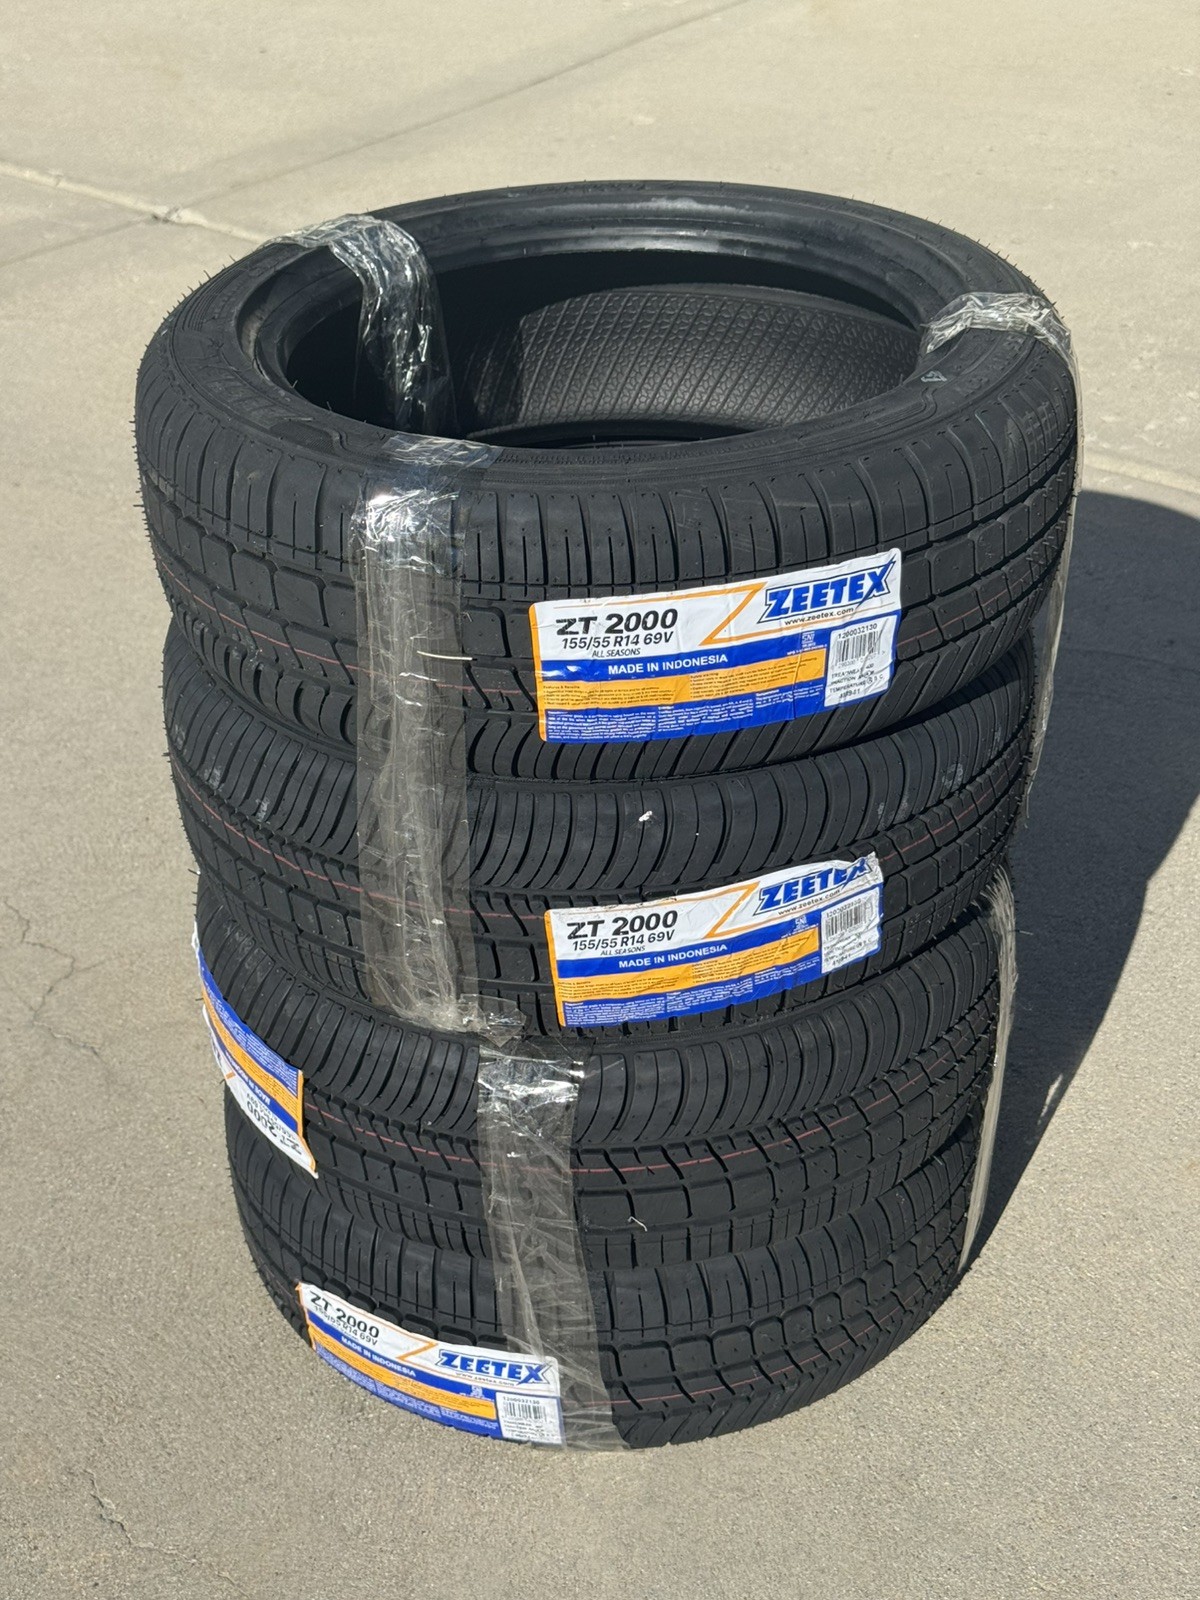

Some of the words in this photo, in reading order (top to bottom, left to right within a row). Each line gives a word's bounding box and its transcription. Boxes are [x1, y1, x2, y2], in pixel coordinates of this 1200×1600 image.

[764, 554, 896, 619] ZEETEX
[555, 616, 598, 635] ZT
[604, 608, 678, 634] 2000
[784, 606, 854, 626] www.zeetex.com
[562, 636, 611, 650] 155/55
[613, 634, 640, 647] R14
[643, 631, 674, 645] 69V
[592, 650, 605, 658] ALL
[606, 647, 641, 657] SEASONS
[608, 663, 644, 675] MADE
[647, 662, 659, 672] IN
[662, 654, 728, 671] INDONESIA
[759, 858, 867, 911] ZEETEX
[566, 919, 605, 940] ZT
[612, 910, 678, 936] 2000
[572, 938, 618, 951] 155/55
[620, 934, 645, 947] R14
[647, 930, 675, 944] 69V
[614, 945, 646, 955] SEASONS
[618, 957, 652, 968] MADE
[654, 955, 665, 964] IN
[667, 944, 728, 962] INDONESIA
[310, 1290, 332, 1312] ZT
[336, 1307, 380, 1339] 2000
[359, 1331, 378, 1346] 69V
[341, 1336, 363, 1353] MADE
[363, 1347, 371, 1358] IN
[372, 1354, 417, 1378] INDONESIA
[440, 1352, 549, 1386] ZEETEX
